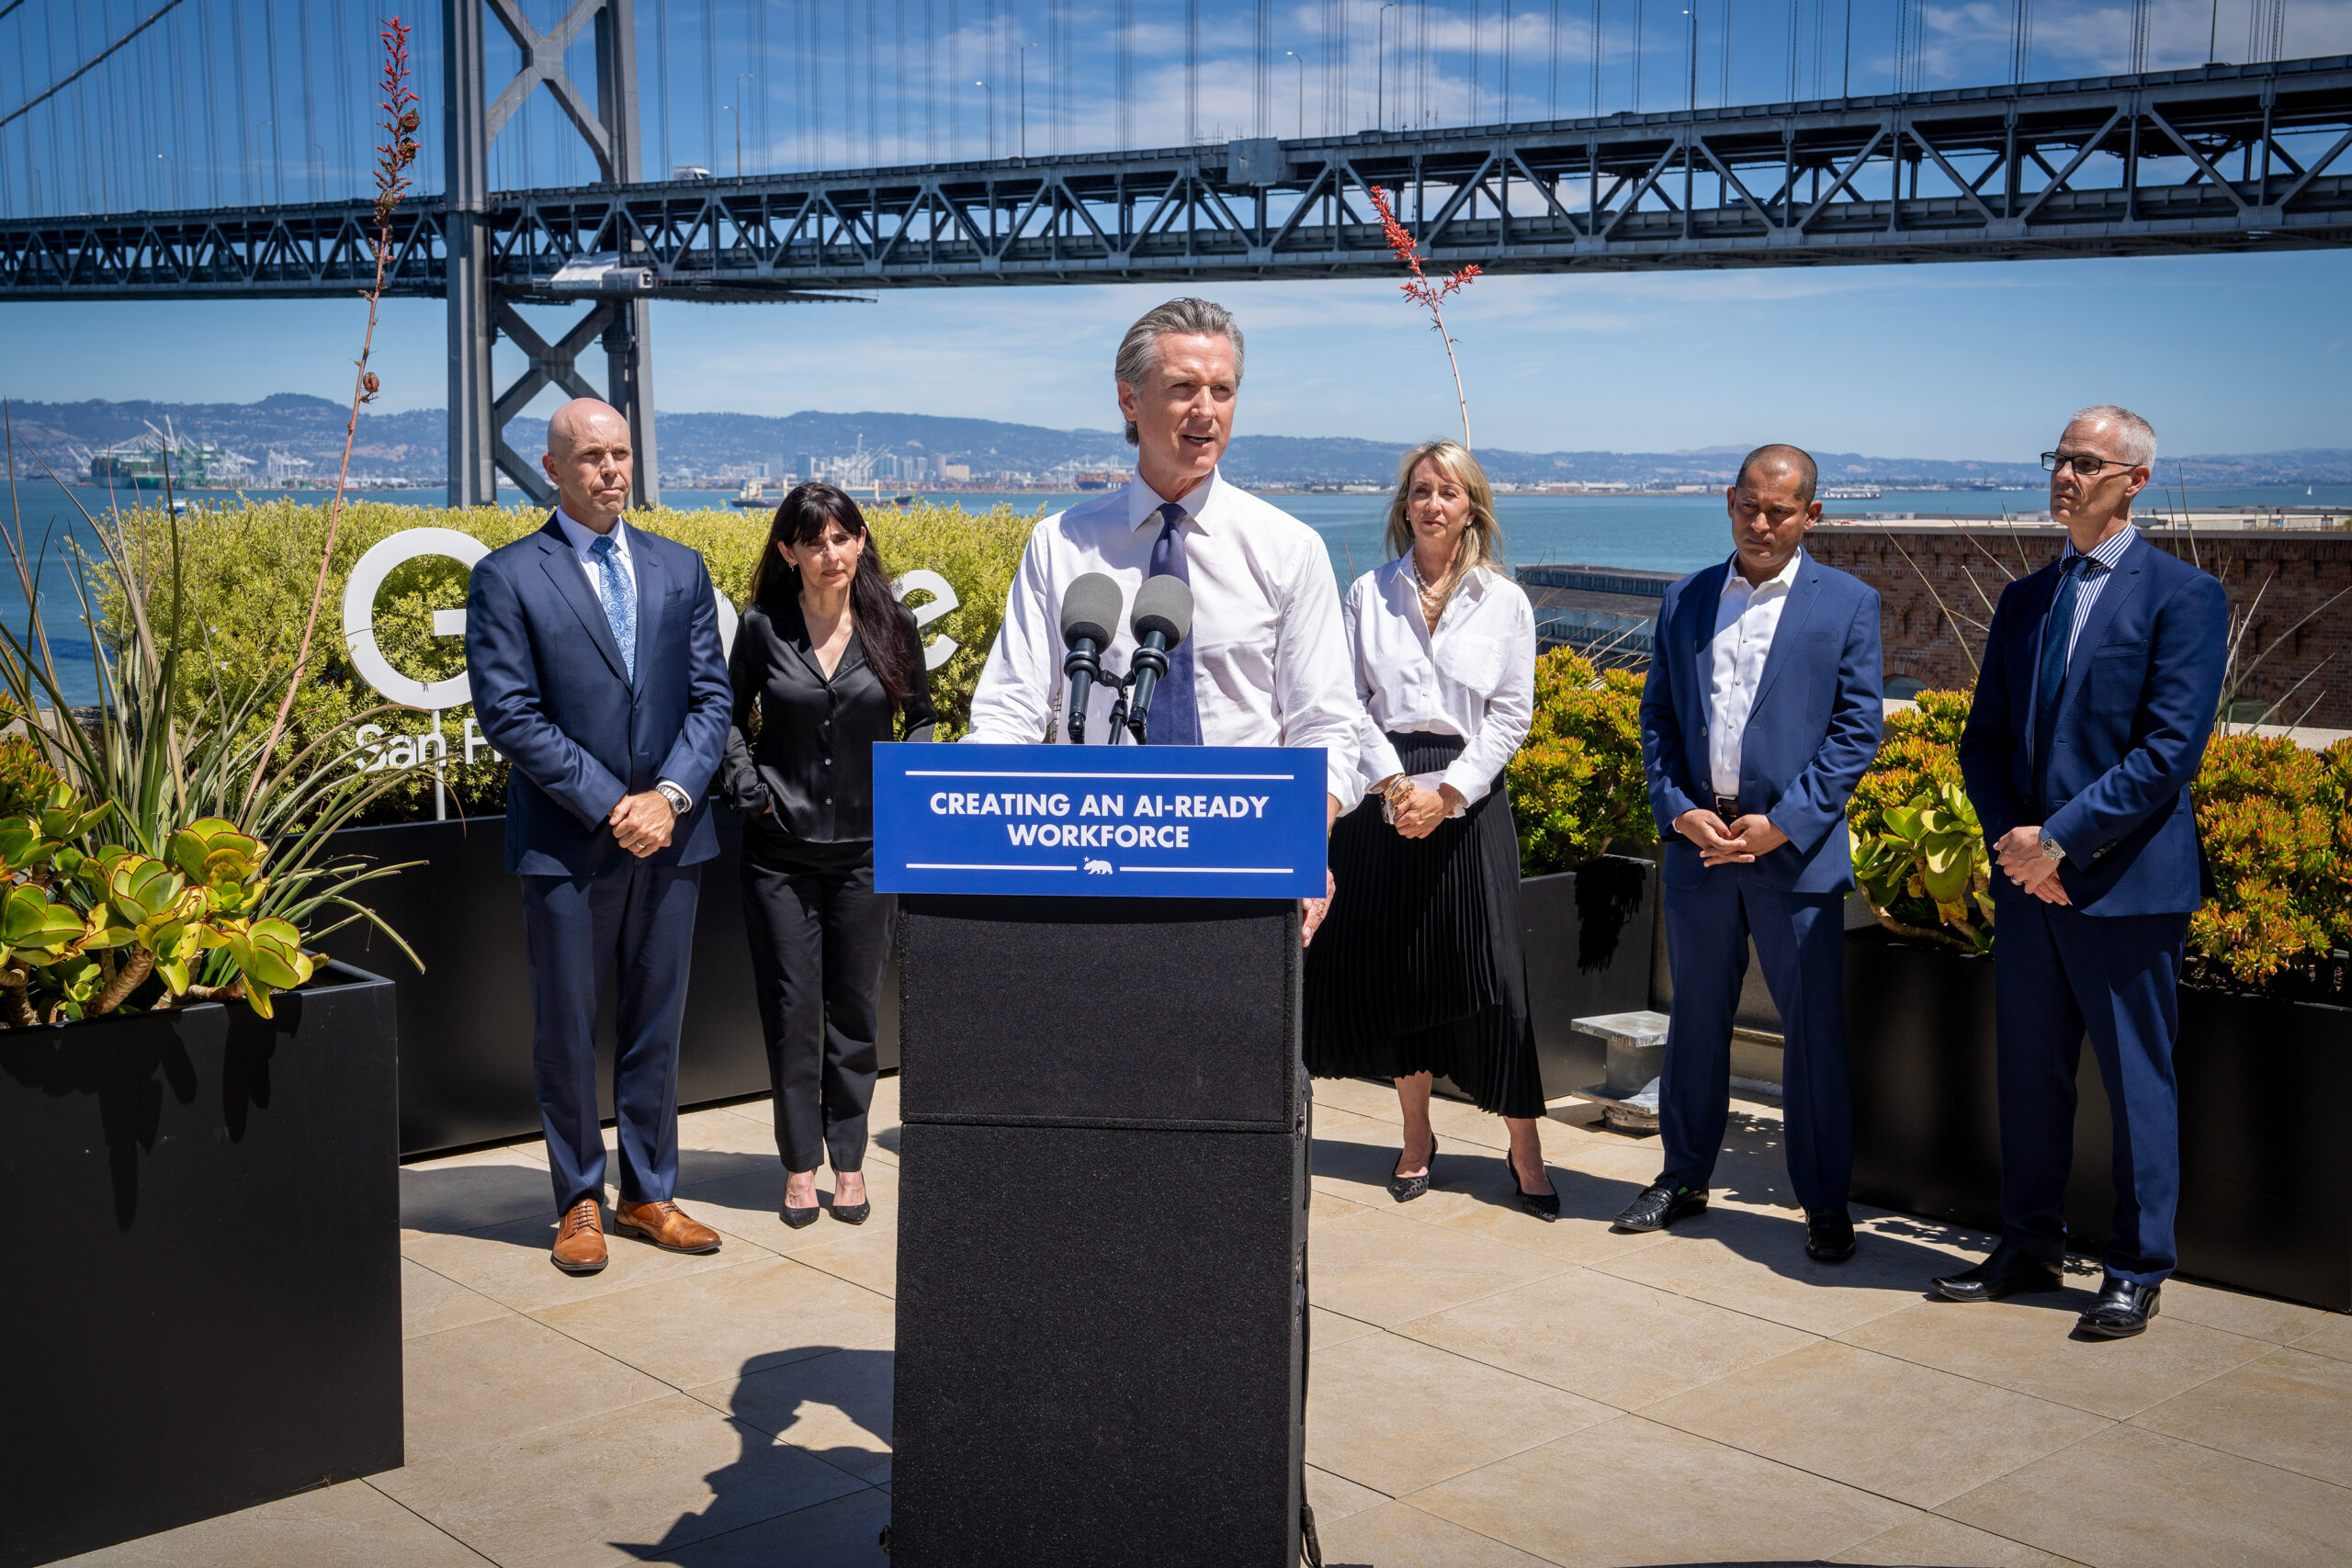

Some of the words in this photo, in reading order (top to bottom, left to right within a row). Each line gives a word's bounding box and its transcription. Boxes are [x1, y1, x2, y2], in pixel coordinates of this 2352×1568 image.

[356, 724, 447, 773] San
[930, 792, 1071, 817] CREATING
[1079, 794, 1124, 817] AN
[1133, 795, 1270, 818] AI-READY
[1006, 823, 1190, 849] WORKFORCE
